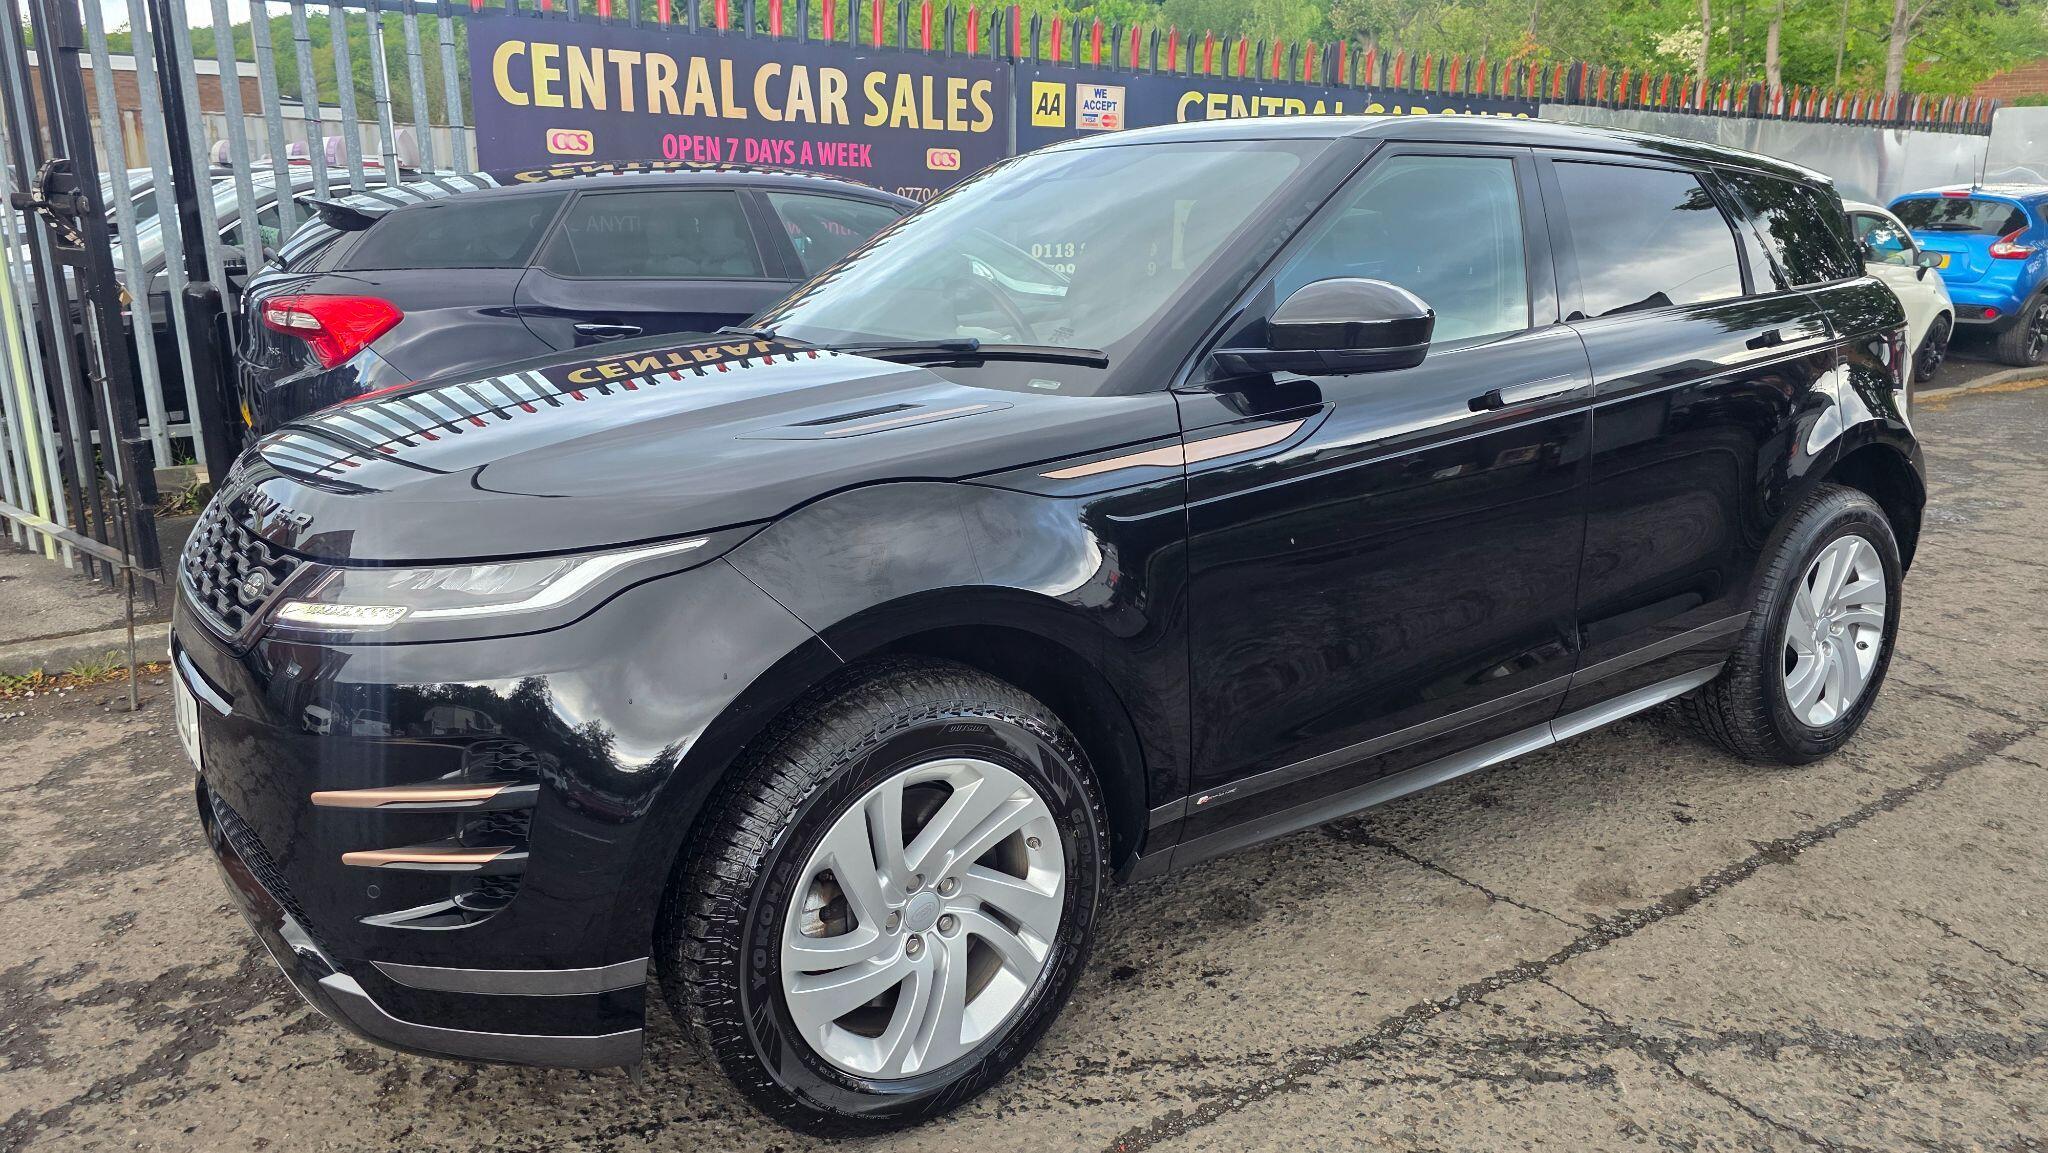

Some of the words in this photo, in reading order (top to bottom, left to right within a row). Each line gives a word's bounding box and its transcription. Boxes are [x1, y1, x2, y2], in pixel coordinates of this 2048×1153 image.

[492, 40, 748, 119] CENTRAL
[753, 62, 849, 125] CAR
[863, 71, 994, 133] SALES
[1094, 88, 1107, 99] WE
[1036, 92, 1060, 116] AA
[1083, 100, 1117, 111] ACCEPT
[662, 133, 721, 162] OPEN
[726, 138, 739, 162] 7
[745, 138, 796, 165] DAYS
[800, 141, 814, 165] A
[818, 142, 873, 168] WEEK
[1031, 242, 1075, 258] 0113
